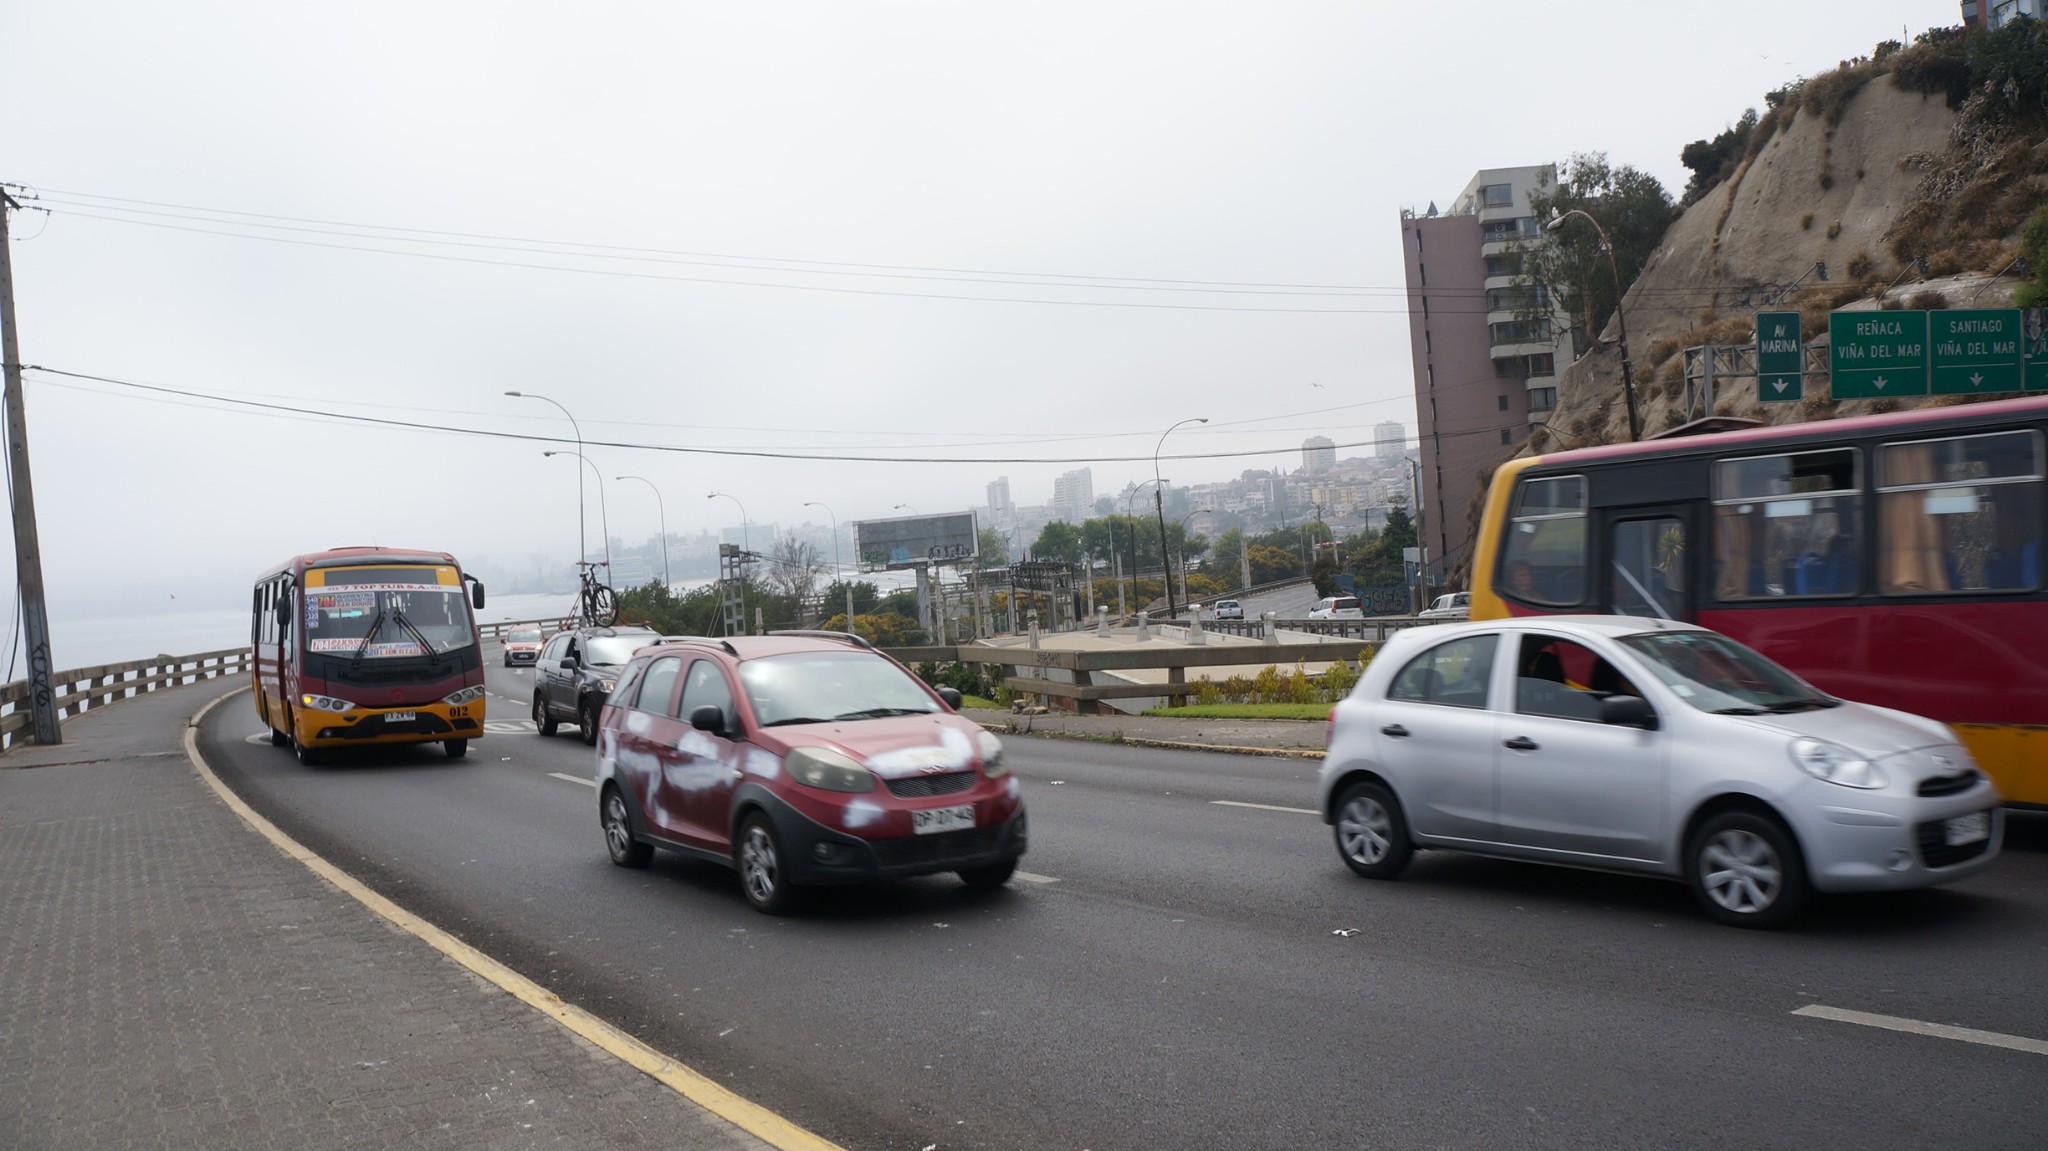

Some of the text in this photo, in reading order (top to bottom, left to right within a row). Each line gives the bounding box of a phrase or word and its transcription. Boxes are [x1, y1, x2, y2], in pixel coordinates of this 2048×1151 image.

[1774, 324, 1786, 338] AV
[1856, 319, 1902, 336] REÑACA
[1949, 319, 2003, 334] SANTIAGO
[1761, 340, 1798, 353] MARINA
[1838, 342, 1921, 359] VIÑA DEL MAR
[1936, 340, 2016, 356] VIÑA DEL MAR
[319, 595, 336, 608] 704
[312, 640, 331, 651] 704
[449, 706, 468, 717] 012
